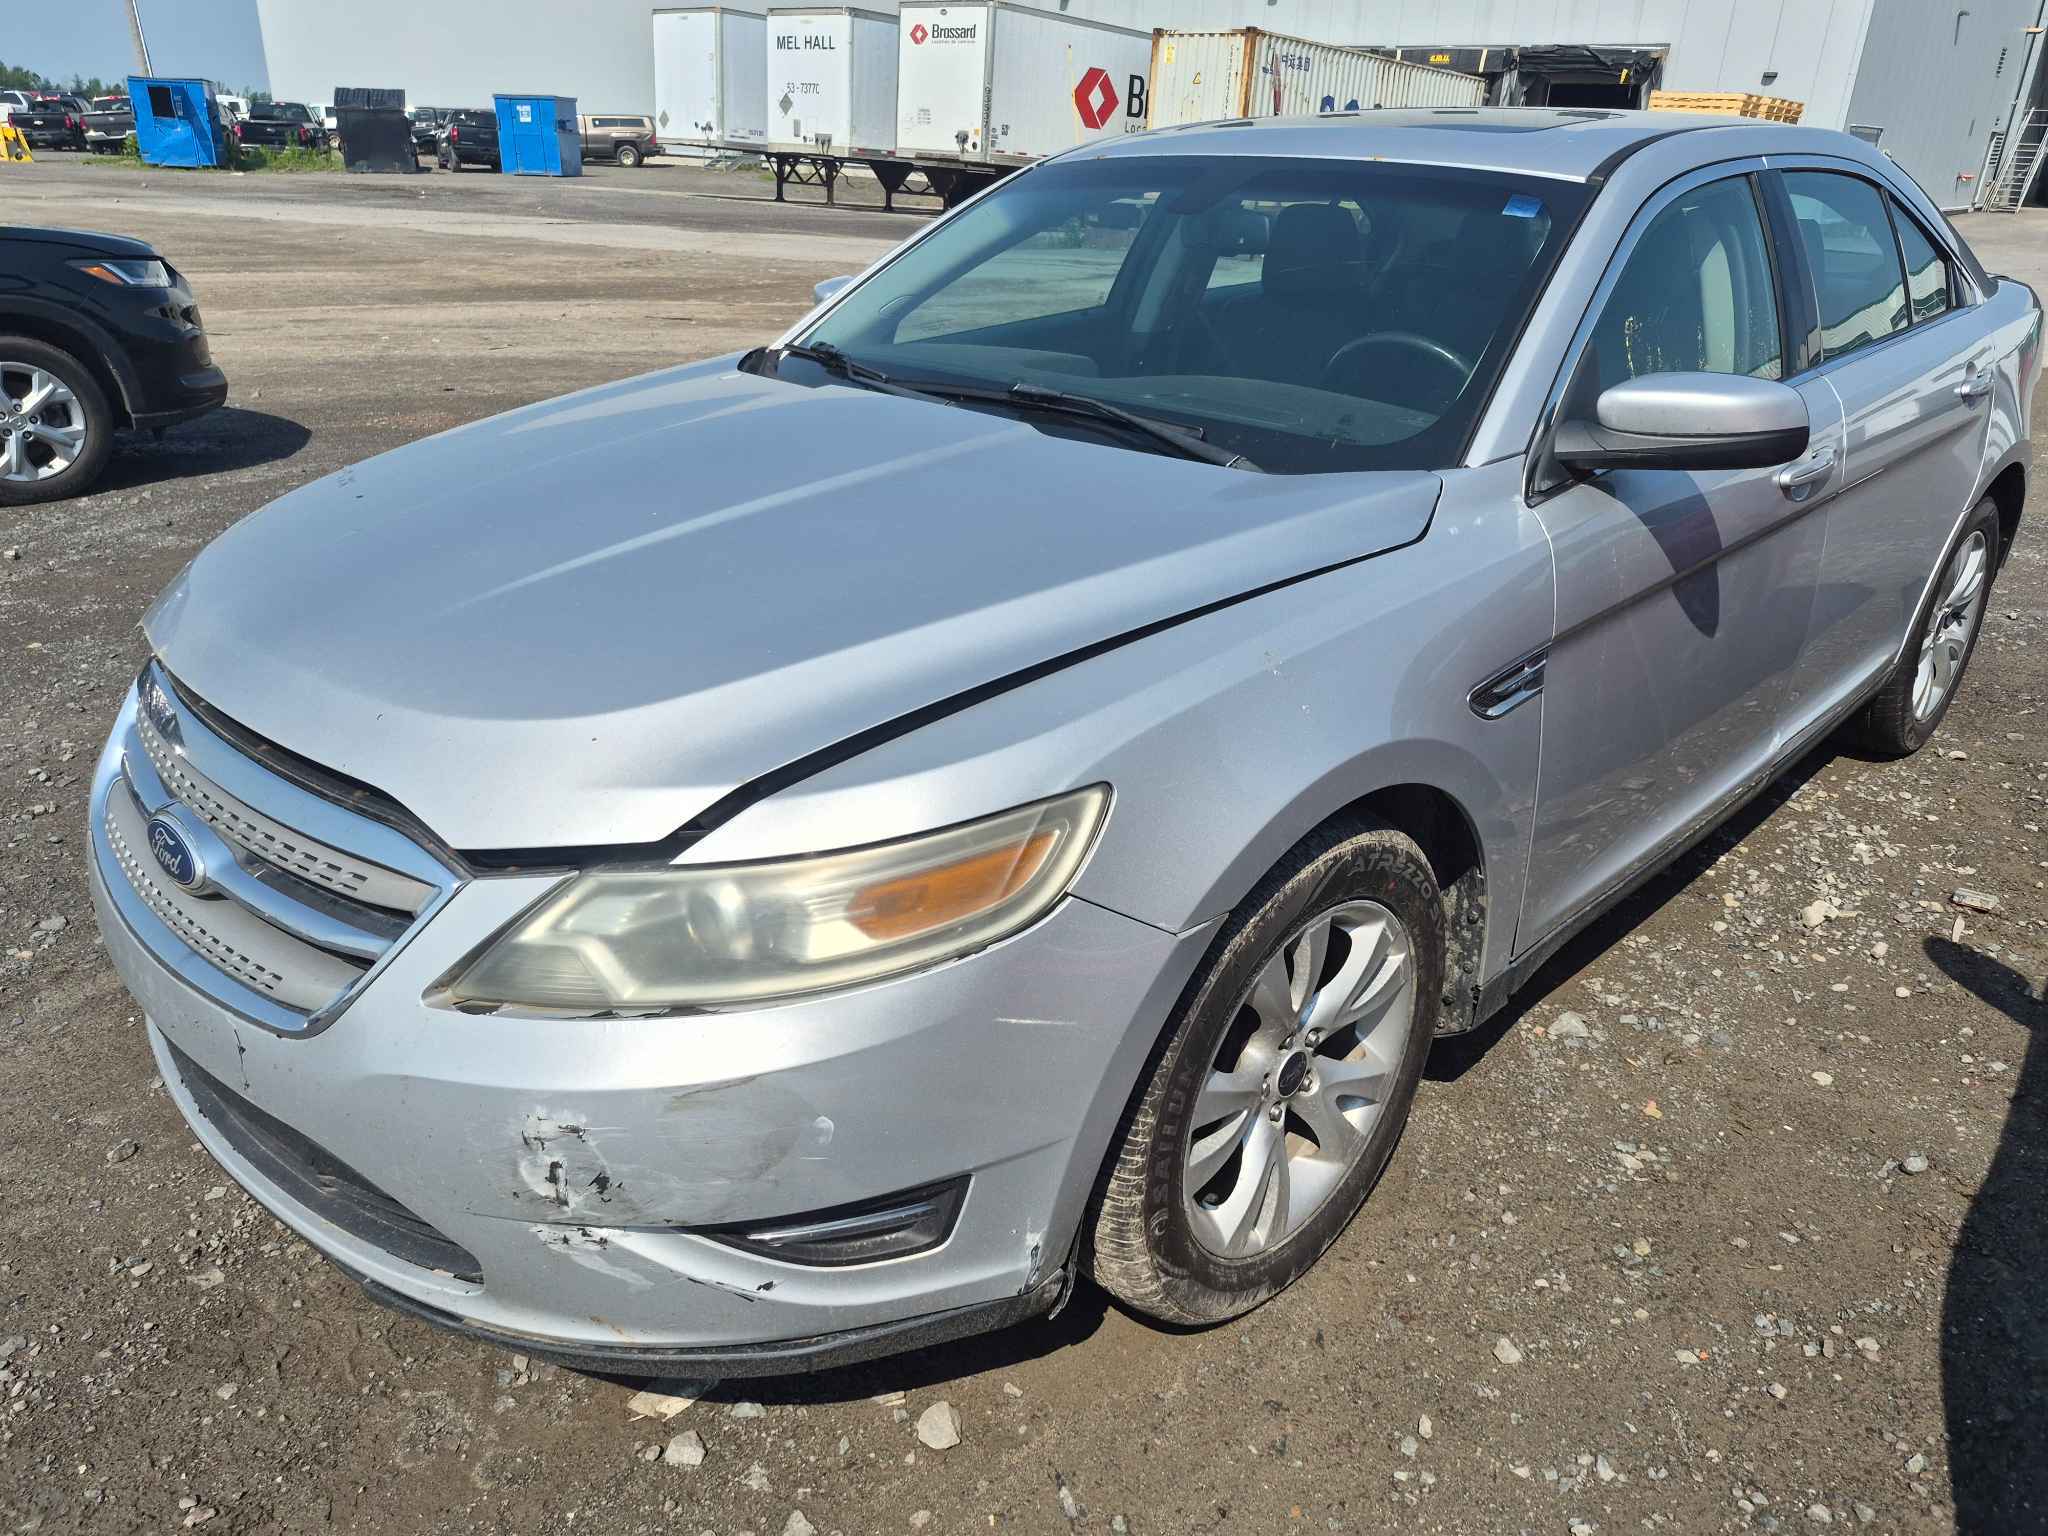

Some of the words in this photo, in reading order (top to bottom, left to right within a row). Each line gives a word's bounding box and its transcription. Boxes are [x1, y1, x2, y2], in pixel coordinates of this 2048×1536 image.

[931, 23, 976, 39] Brossard
[776, 35, 801, 50] MEL
[804, 35, 836, 50] HALL
[151, 826, 182, 875] Ford
